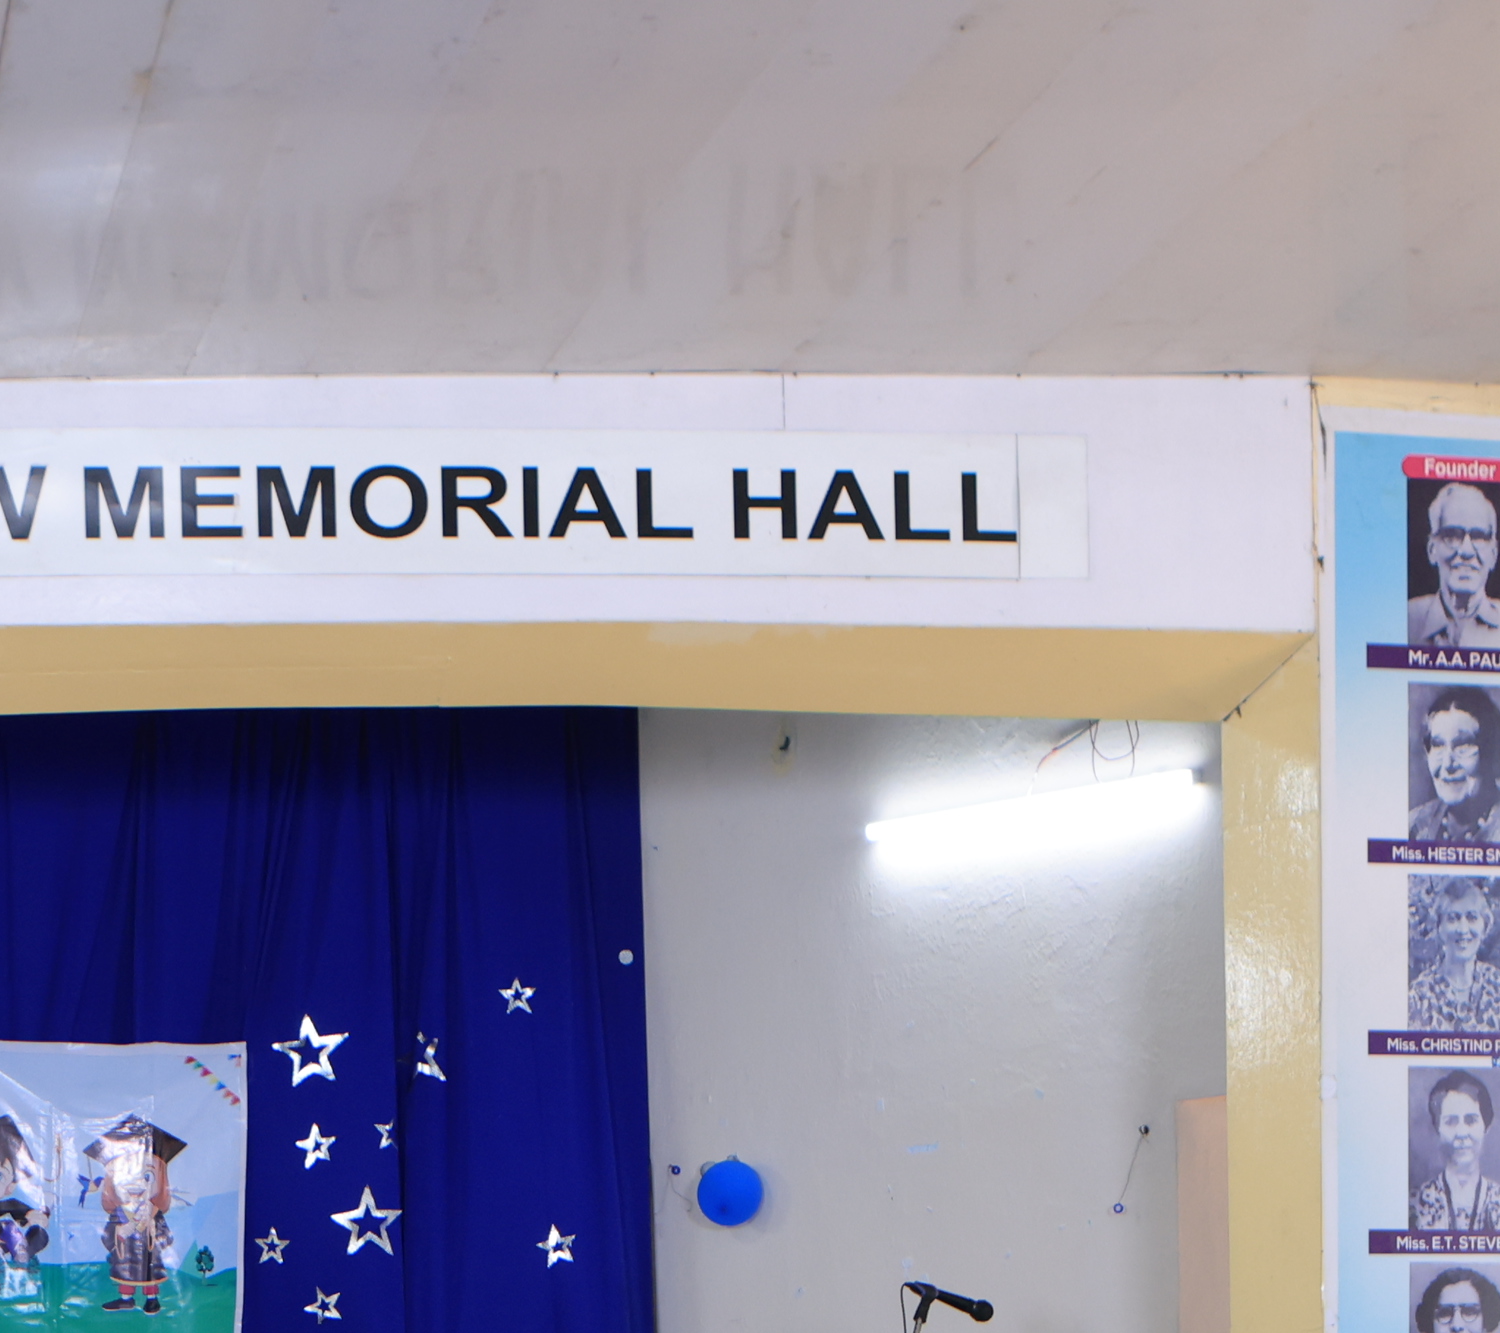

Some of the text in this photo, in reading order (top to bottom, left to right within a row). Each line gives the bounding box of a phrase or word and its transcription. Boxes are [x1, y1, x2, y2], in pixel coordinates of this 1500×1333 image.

[1424, 457, 1497, 480] Founder
[81, 463, 694, 542] MEMORIAL
[731, 467, 1018, 544] HALL
[1408, 649, 1433, 666] Mr.
[1435, 651, 1467, 668] A.A.
[1391, 845, 1426, 862] Miss.
[1427, 846, 1484, 864] HESTER
[1387, 1037, 1419, 1052] Miss.
[1396, 1235, 1430, 1250] Miss.
[1432, 1235, 1457, 1250] E.T.
